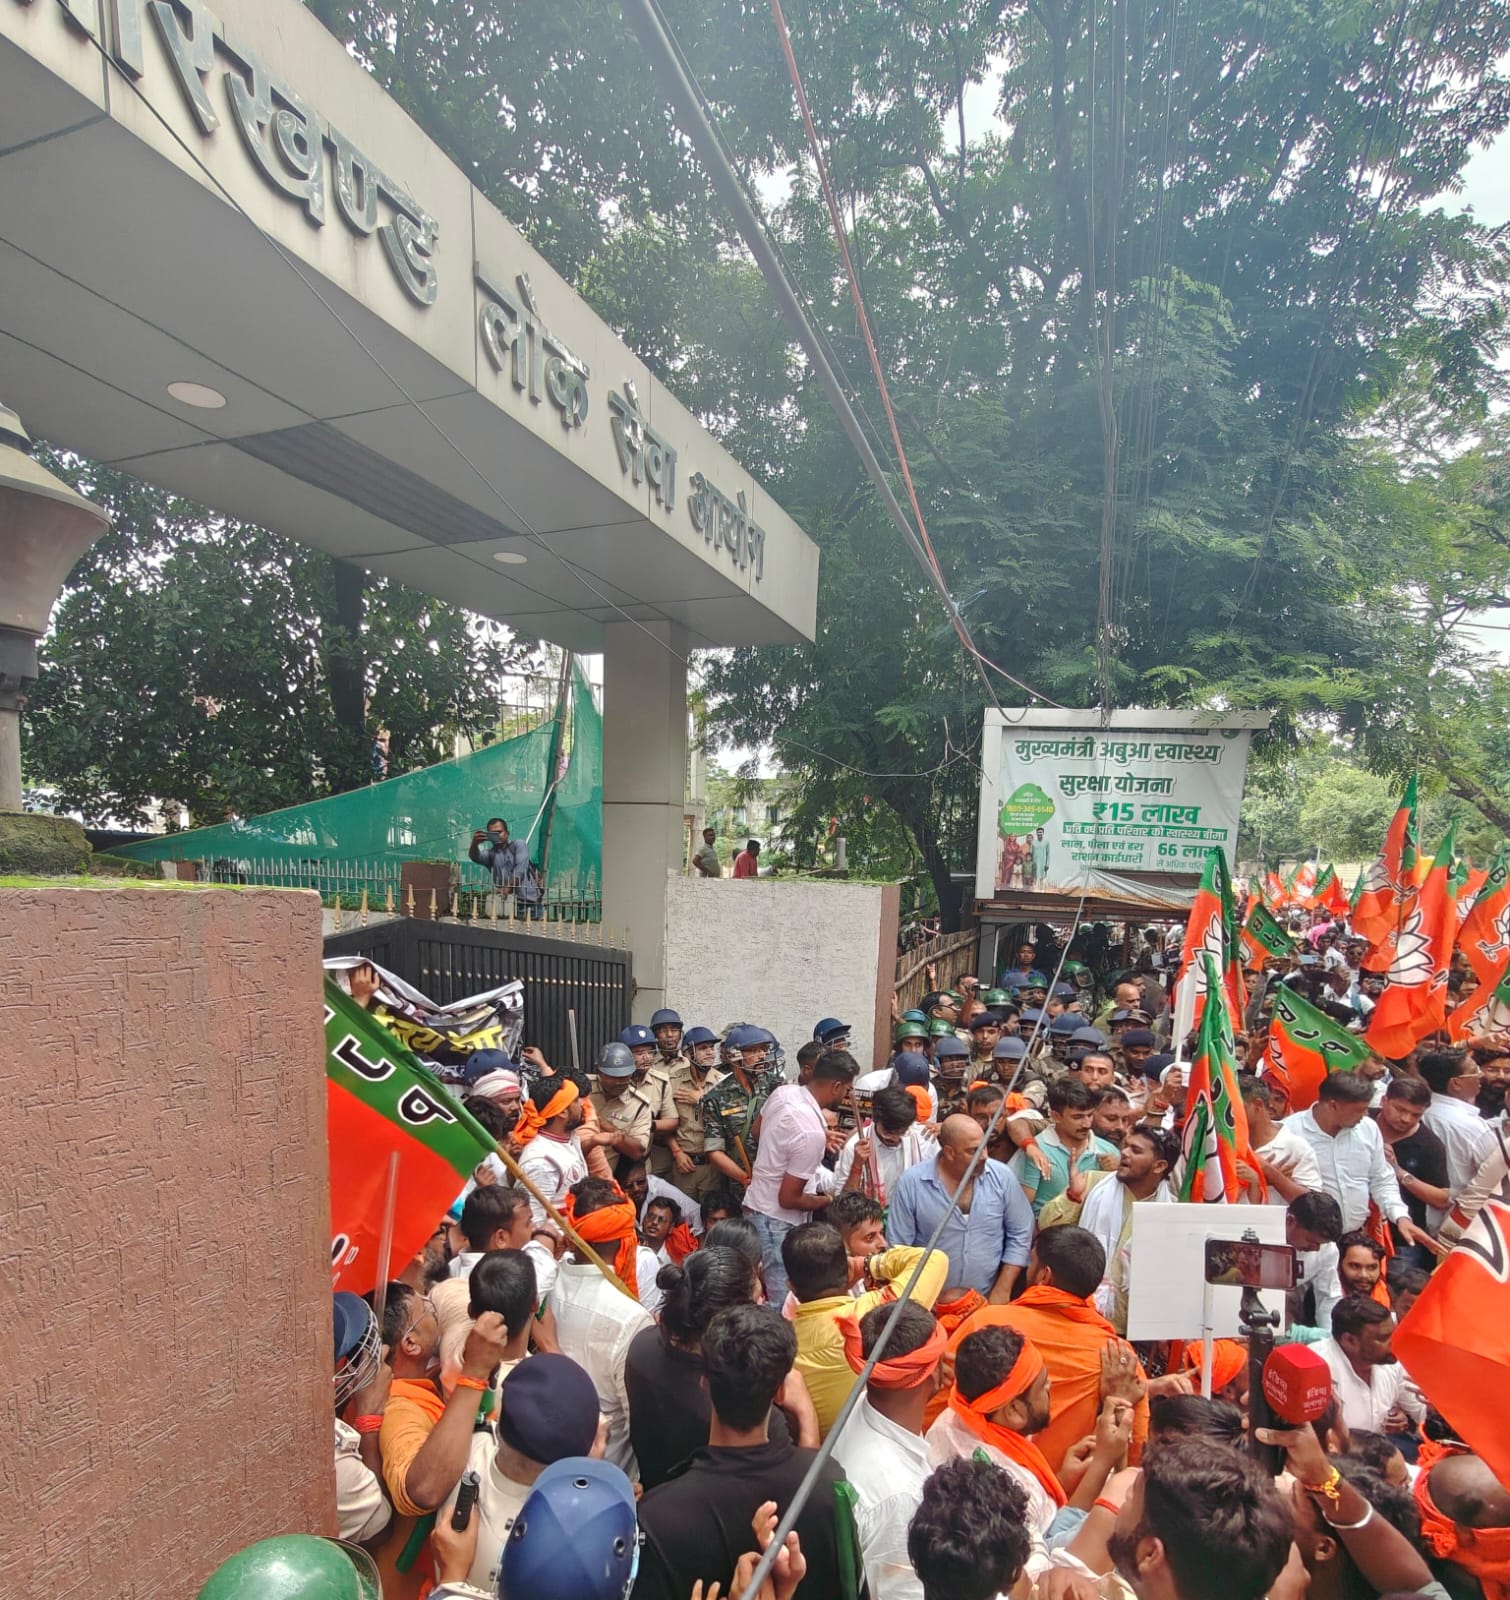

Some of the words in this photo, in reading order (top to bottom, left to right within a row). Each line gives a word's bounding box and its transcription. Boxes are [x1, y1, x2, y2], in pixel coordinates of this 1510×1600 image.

[474, 261, 590, 429] लोक
[607, 379, 677, 513] सेवा
[688, 471, 765, 583] आयोग
[1014, 736, 1097, 761] मुख्यमंत्री
[1100, 742, 1151, 763] अबुआ
[1154, 743, 1221, 761] स्वास्थ्य
[1059, 775, 1111, 796] सुरक्षा
[1114, 772, 1173, 793] योजना
[1092, 802, 1134, 821] ₹15
[1141, 804, 1201, 824] लाख
[1065, 822, 1081, 834] प्रति
[1117, 825, 1147, 836] परिवार
[1152, 826, 1164, 837] को
[1167, 828, 1200, 839] स्वास्थ्य
[1087, 838, 1109, 849] पीला
[1112, 840, 1124, 850] एवं
[1158, 843, 1177, 856] 66
